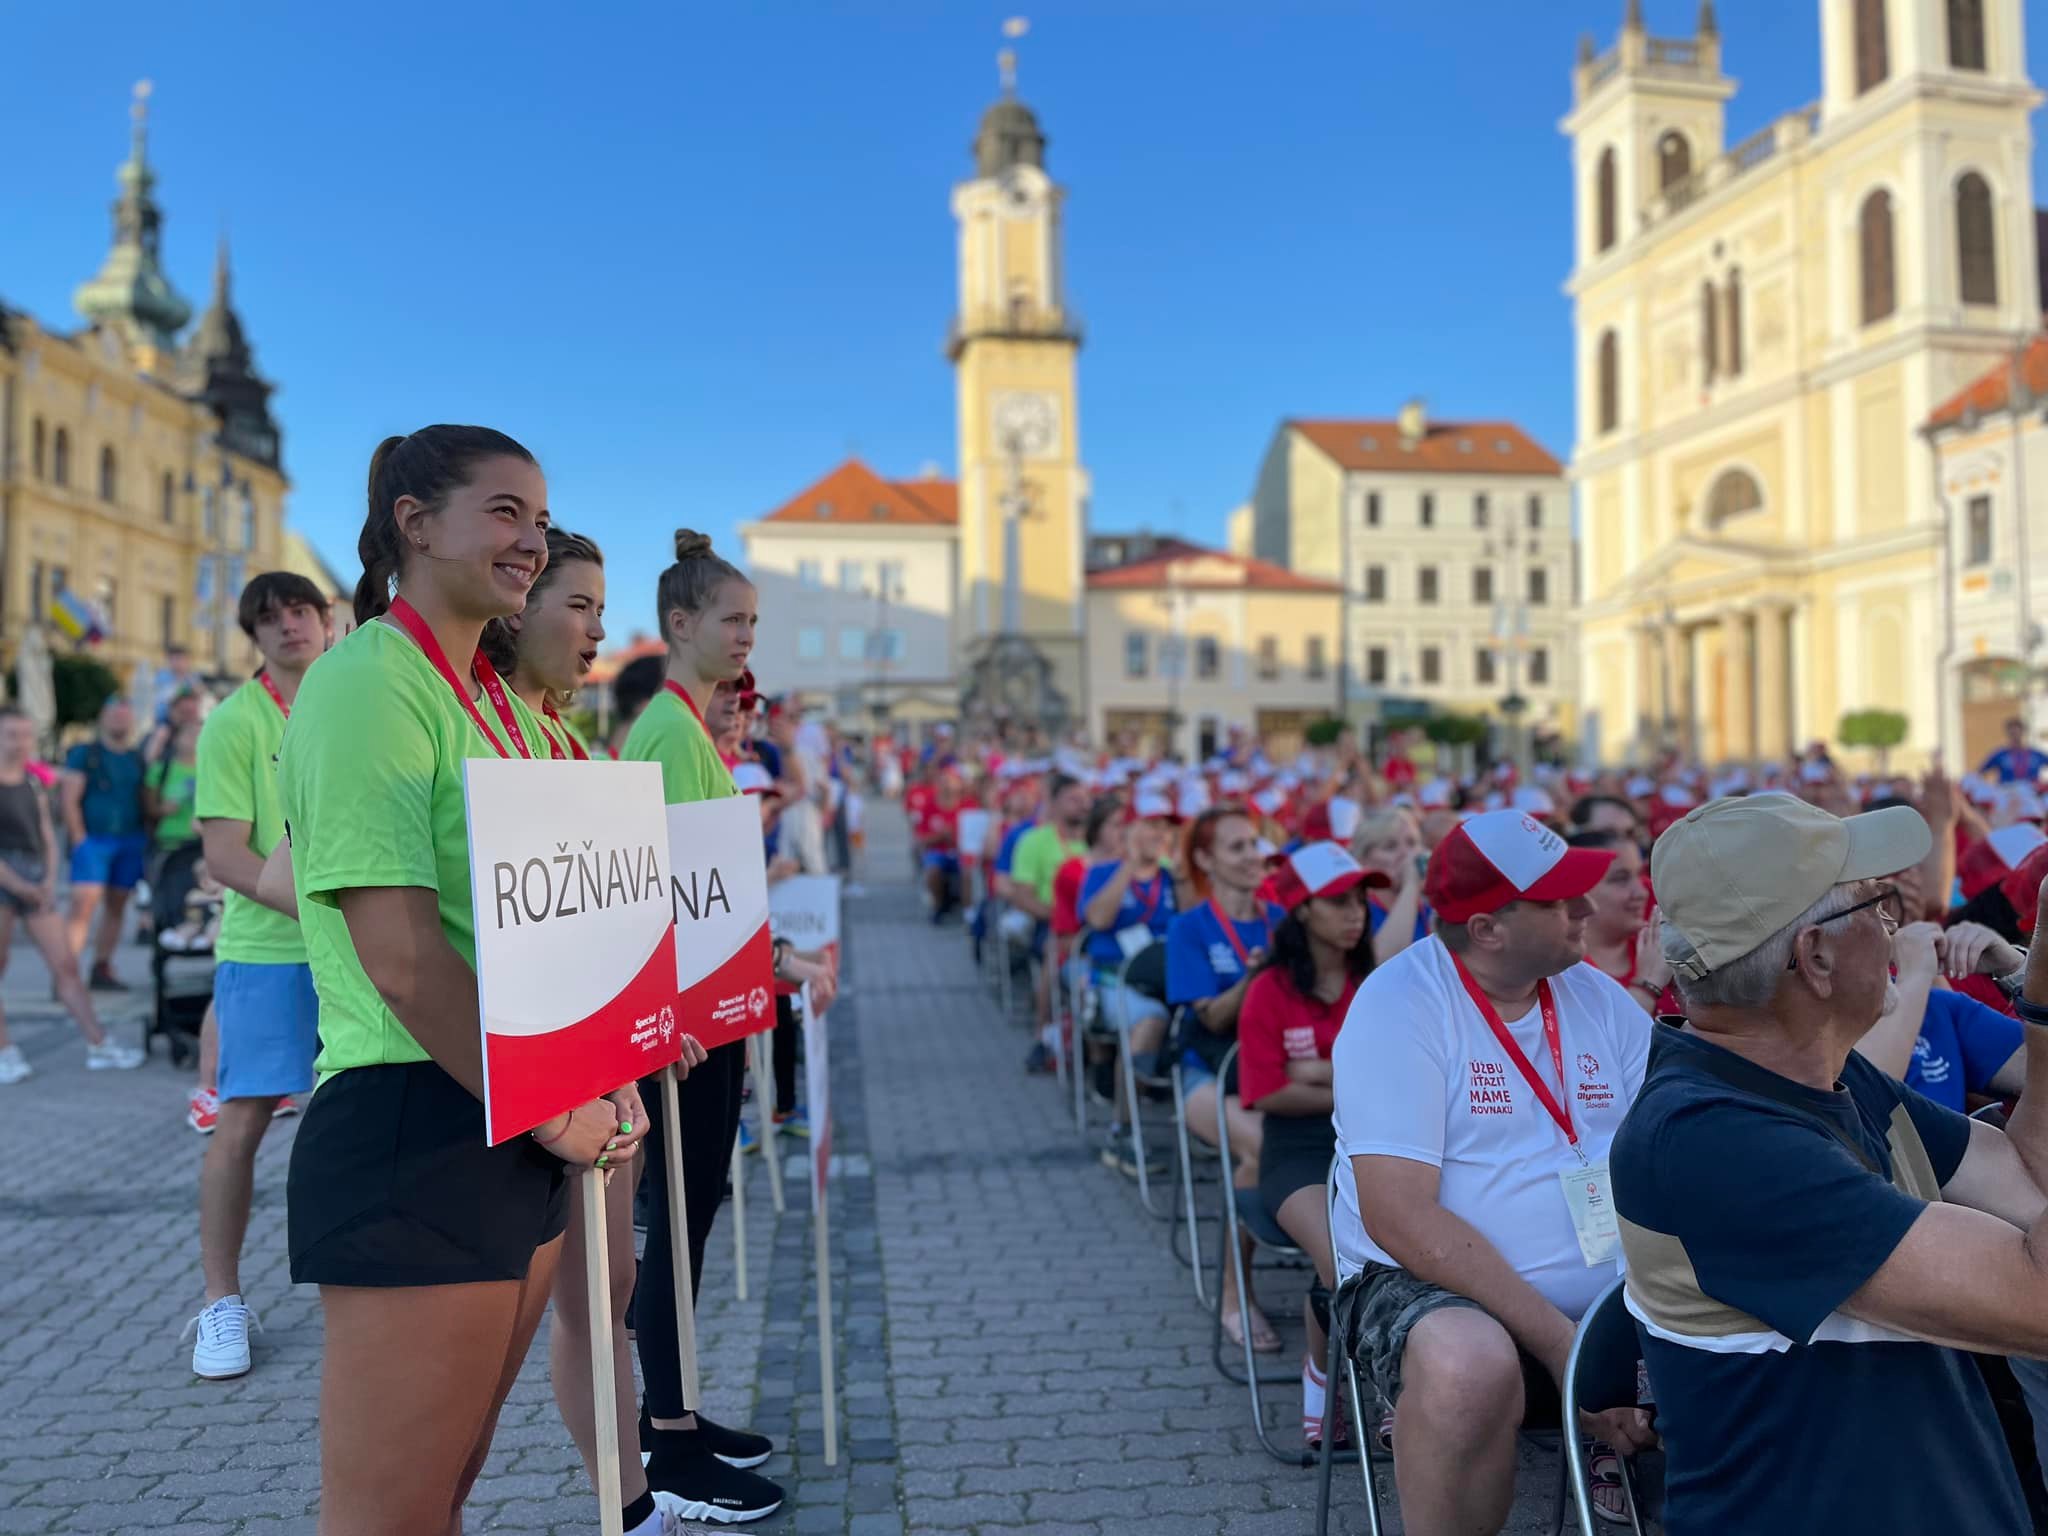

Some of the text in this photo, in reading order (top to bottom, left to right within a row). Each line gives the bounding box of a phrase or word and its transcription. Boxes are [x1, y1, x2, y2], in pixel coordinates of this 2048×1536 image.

[494, 840, 664, 929] ROŽŇAVA
[635, 1012, 657, 1030] Special
[630, 1027, 657, 1044] Olympics
[1469, 1059, 1504, 1074] ÚŽBU
[1469, 1087, 1512, 1103] MÁME
[1579, 1082, 1609, 1092] Special
[1577, 1092, 1614, 1101] Olympics
